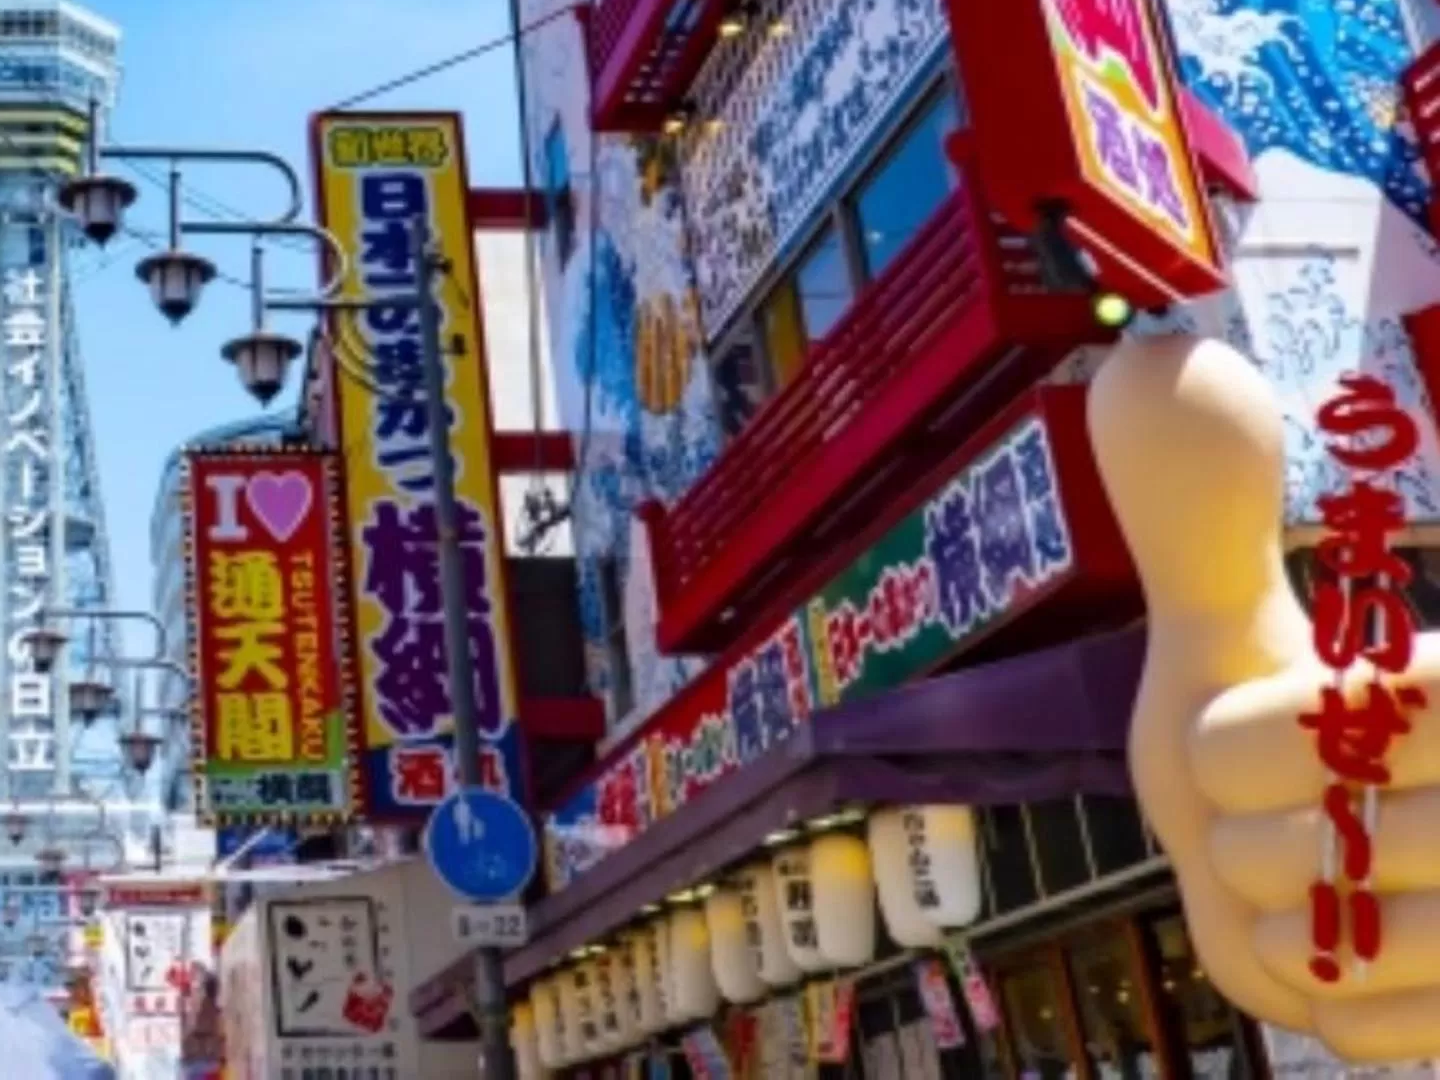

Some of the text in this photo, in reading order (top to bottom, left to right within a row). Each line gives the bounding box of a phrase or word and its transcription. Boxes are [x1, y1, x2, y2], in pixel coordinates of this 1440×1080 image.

[205, 475, 248, 542] I
[209, 549, 295, 762] 通天閣
[289, 548, 325, 761] TSUTENKAKU
